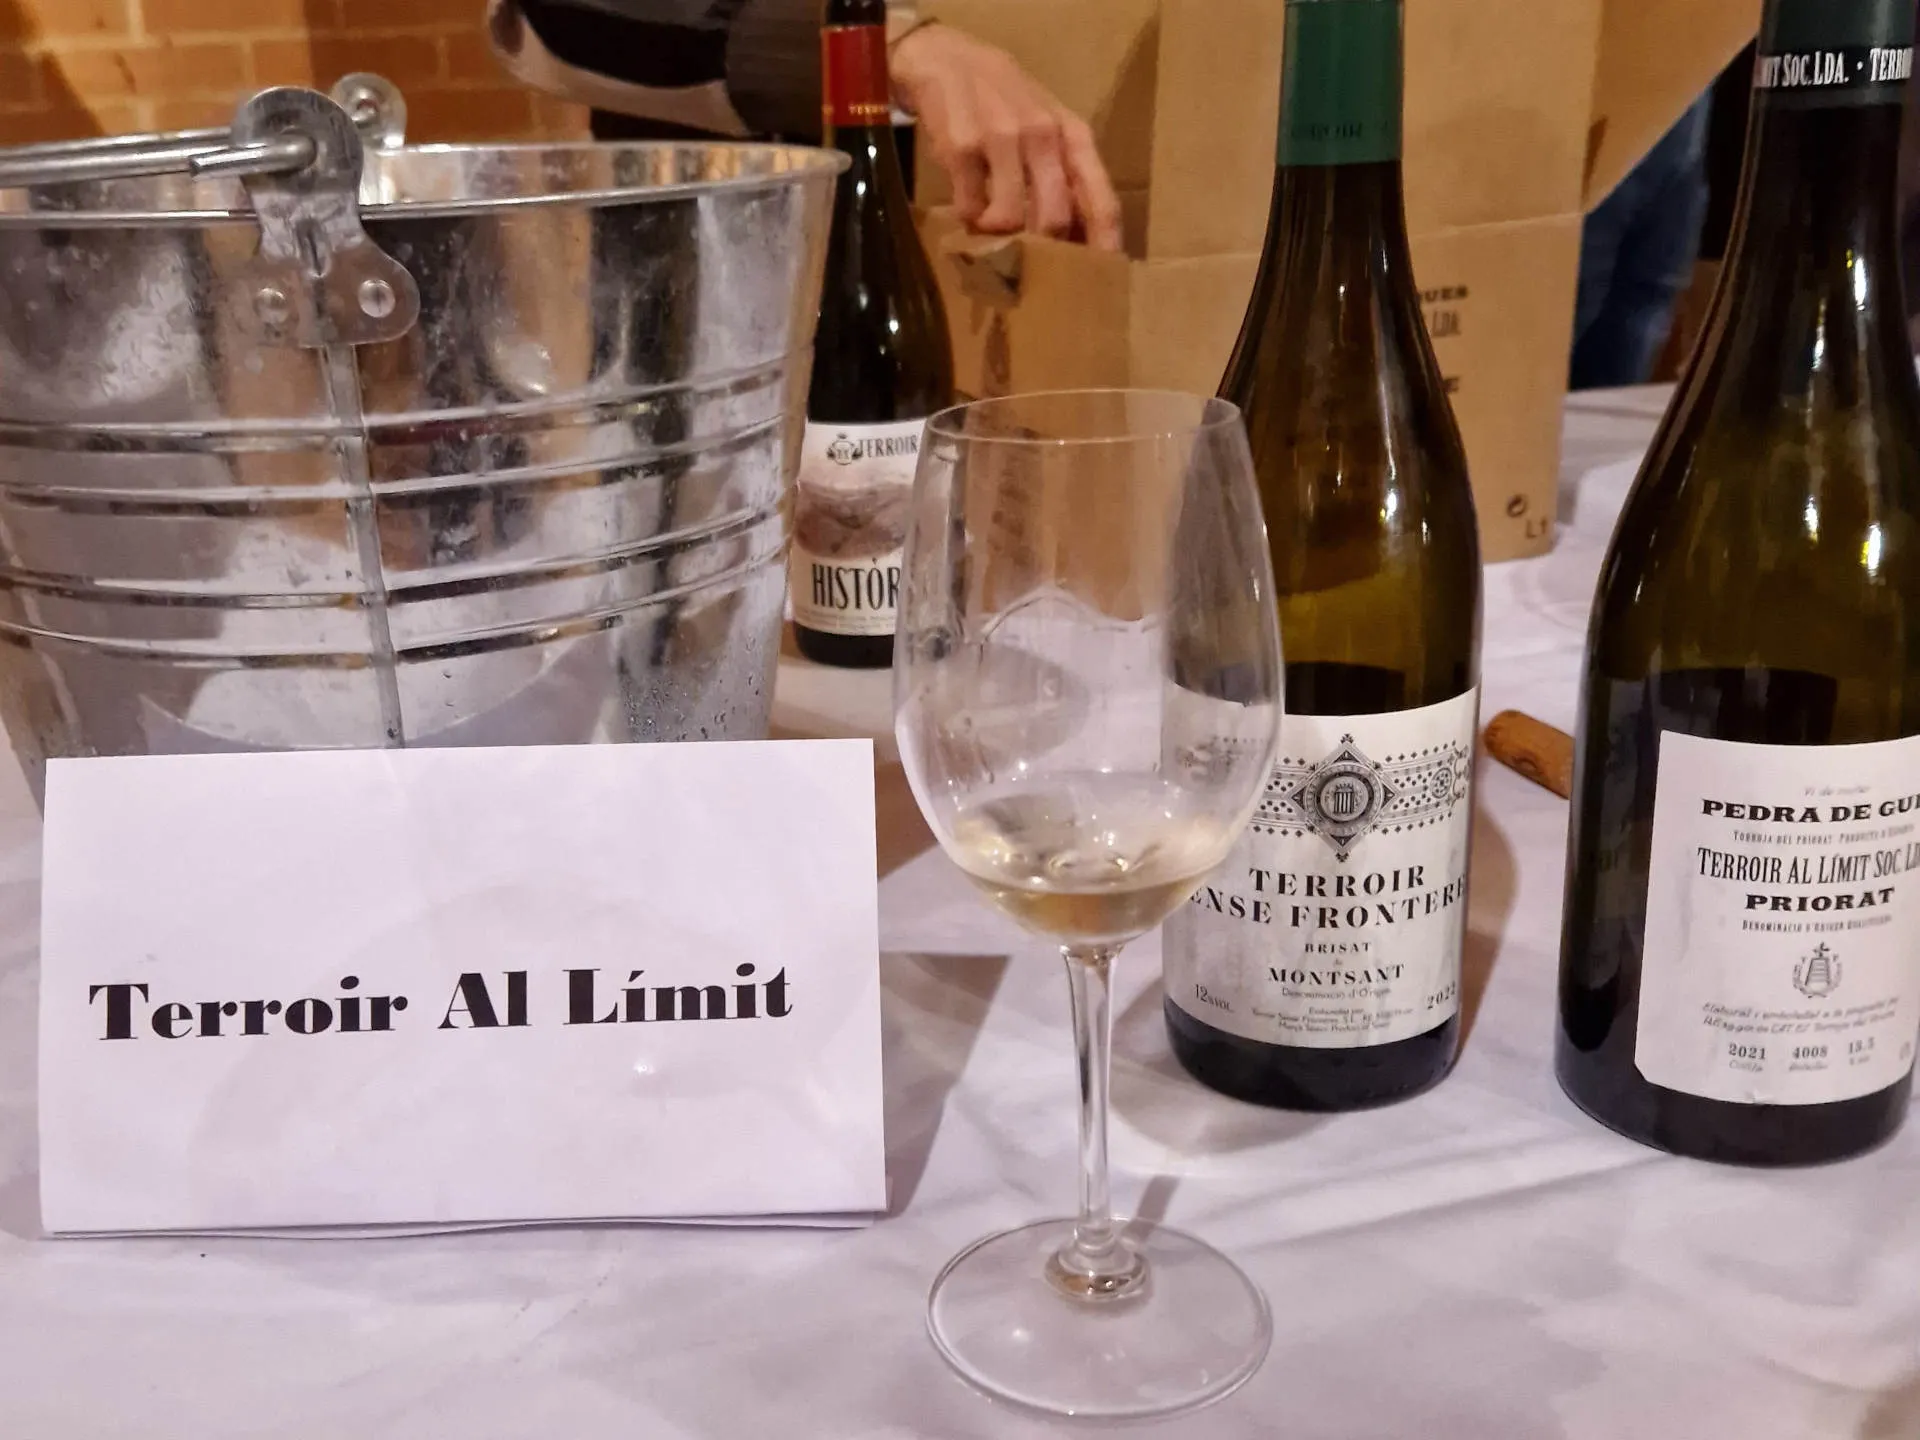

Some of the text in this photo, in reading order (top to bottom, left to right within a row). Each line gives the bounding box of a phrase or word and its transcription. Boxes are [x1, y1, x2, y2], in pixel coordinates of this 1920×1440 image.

[1701, 798, 1822, 824] PEDRA
[1830, 803, 1872, 822] DE
[1698, 847, 1782, 884] TERROIR
[1787, 855, 1812, 884] AL
[1817, 852, 1872, 884] LÍMIT
[1249, 864, 1425, 897] TERROIR
[1744, 886, 1896, 913] PRIORAT
[1304, 942, 1371, 954] BRISAT
[1267, 963, 1406, 986] MONTSANT
[89, 962, 794, 1042] Terroir Al Límit
[1728, 1043, 1767, 1060] 2021
[1792, 1046, 1829, 1059] 4008
